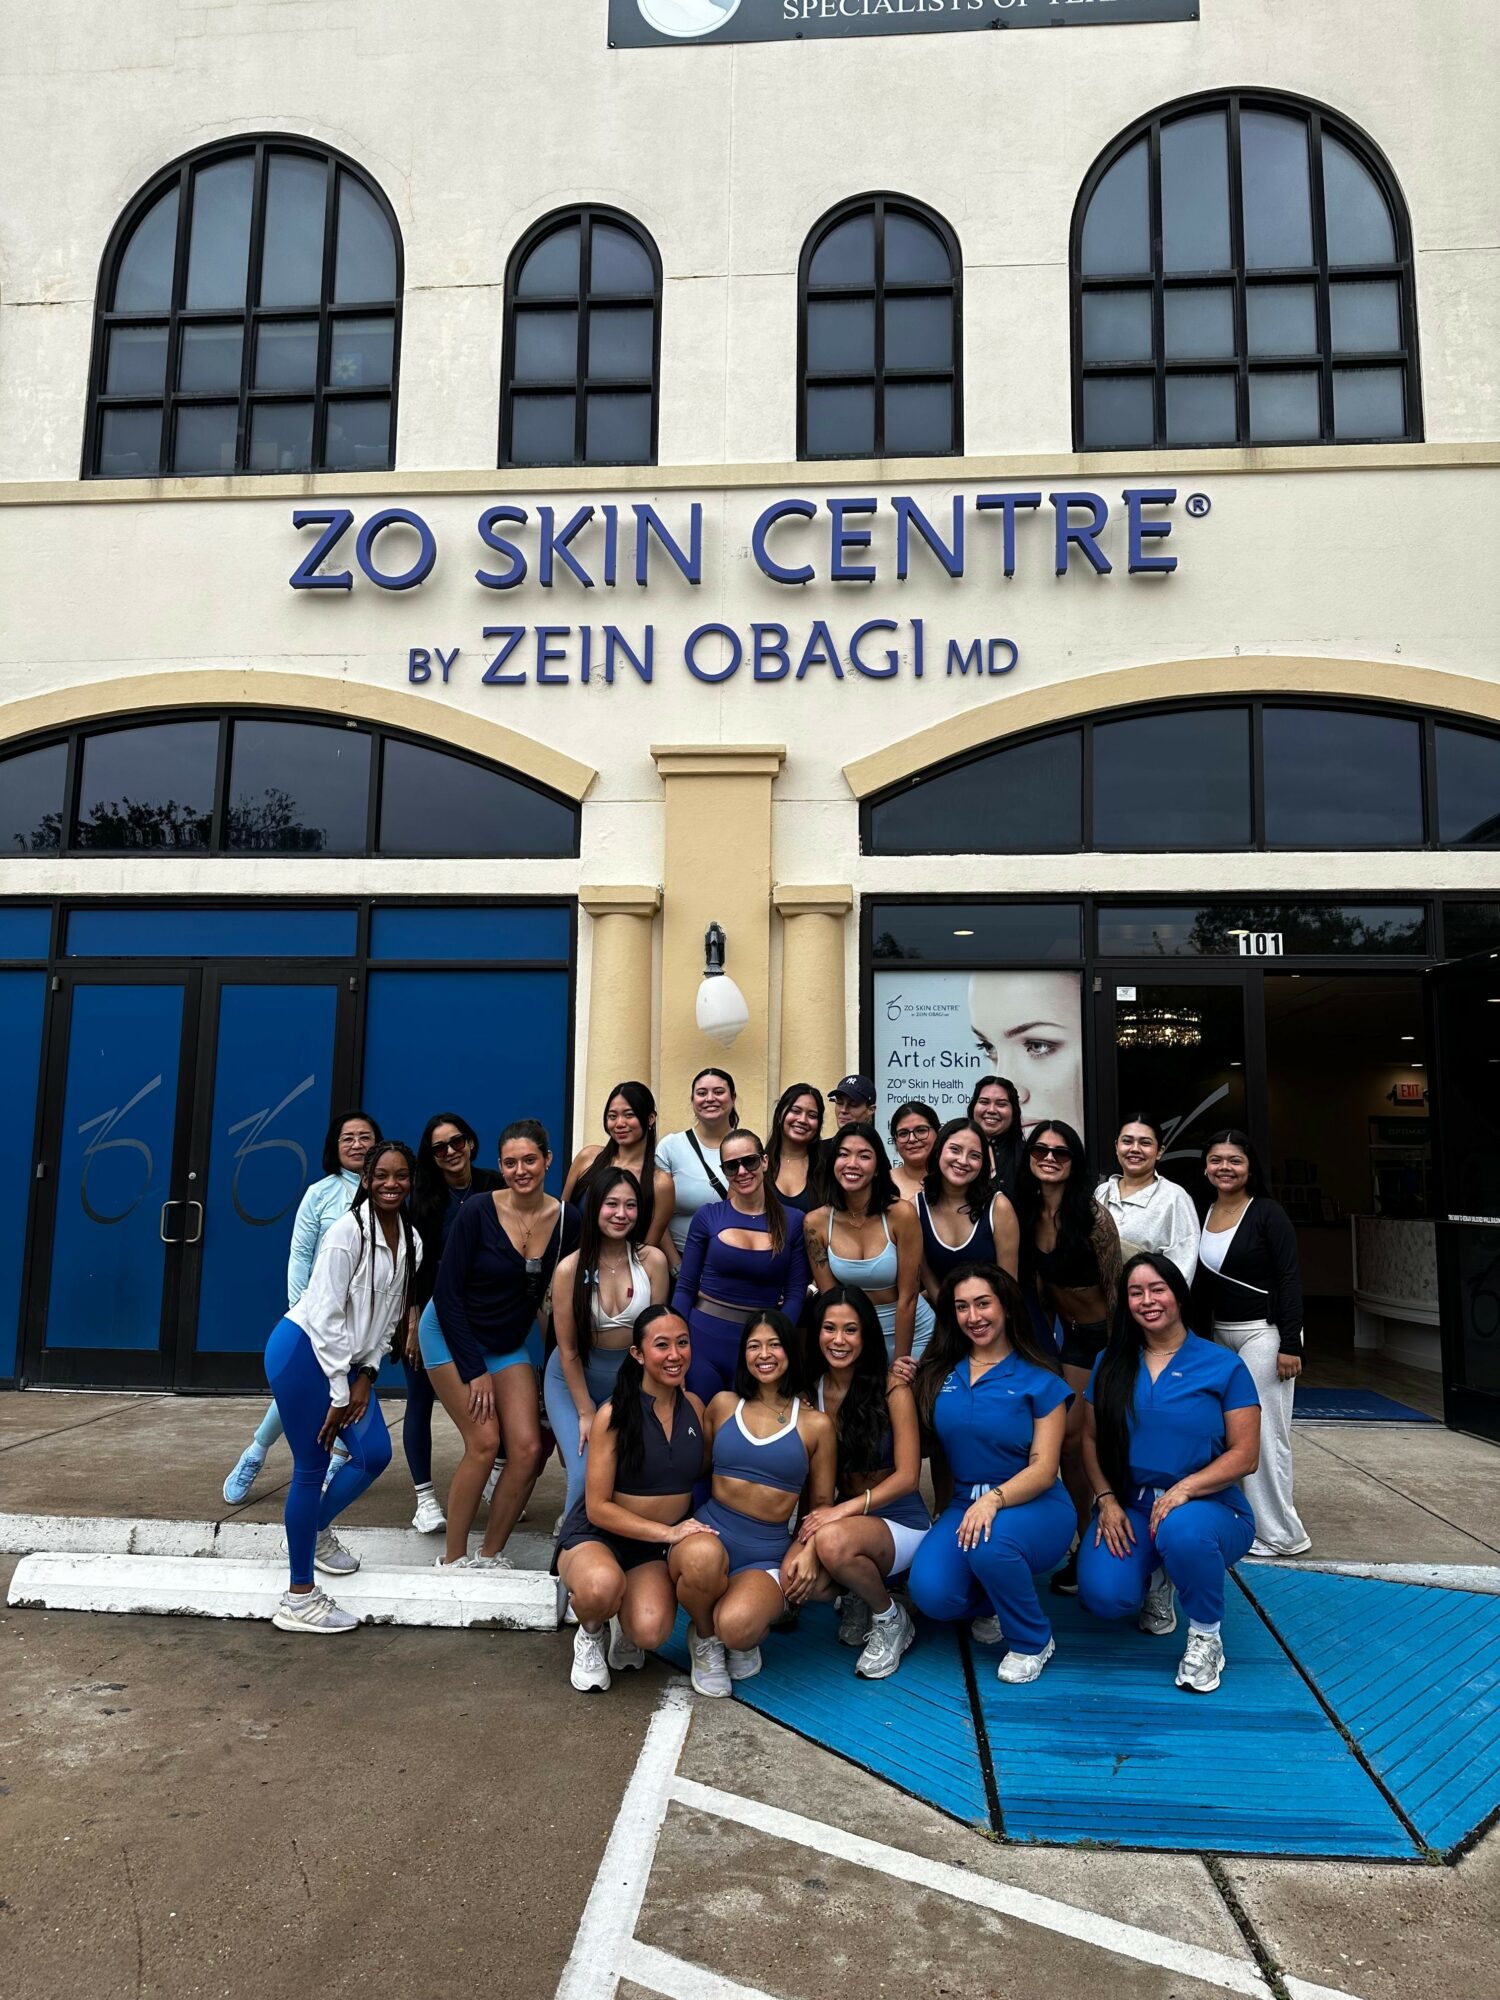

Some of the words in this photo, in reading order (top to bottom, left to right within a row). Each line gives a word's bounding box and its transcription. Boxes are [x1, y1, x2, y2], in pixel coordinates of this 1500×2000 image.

[289, 508, 437, 591] ZO
[475, 503, 703, 590] SKIN
[408, 648, 460, 684] BY
[481, 625, 654, 685] ZEIN
[684, 618, 924, 684] OBAGI
[946, 638, 1019, 675] MD
[1242, 933, 1281, 955] 101
[901, 1036, 926, 1047] The
[887, 1050, 920, 1068] Art
[922, 1056, 937, 1068] of
[940, 1050, 980, 1068] Skin
[908, 1078, 929, 1089] Skin
[932, 1078, 964, 1089] Health
[1401, 1084, 1420, 1098] EXIT
[887, 1093, 926, 1104] Products
[928, 1093, 940, 1106] by
[942, 1093, 955, 1104] Dr.
